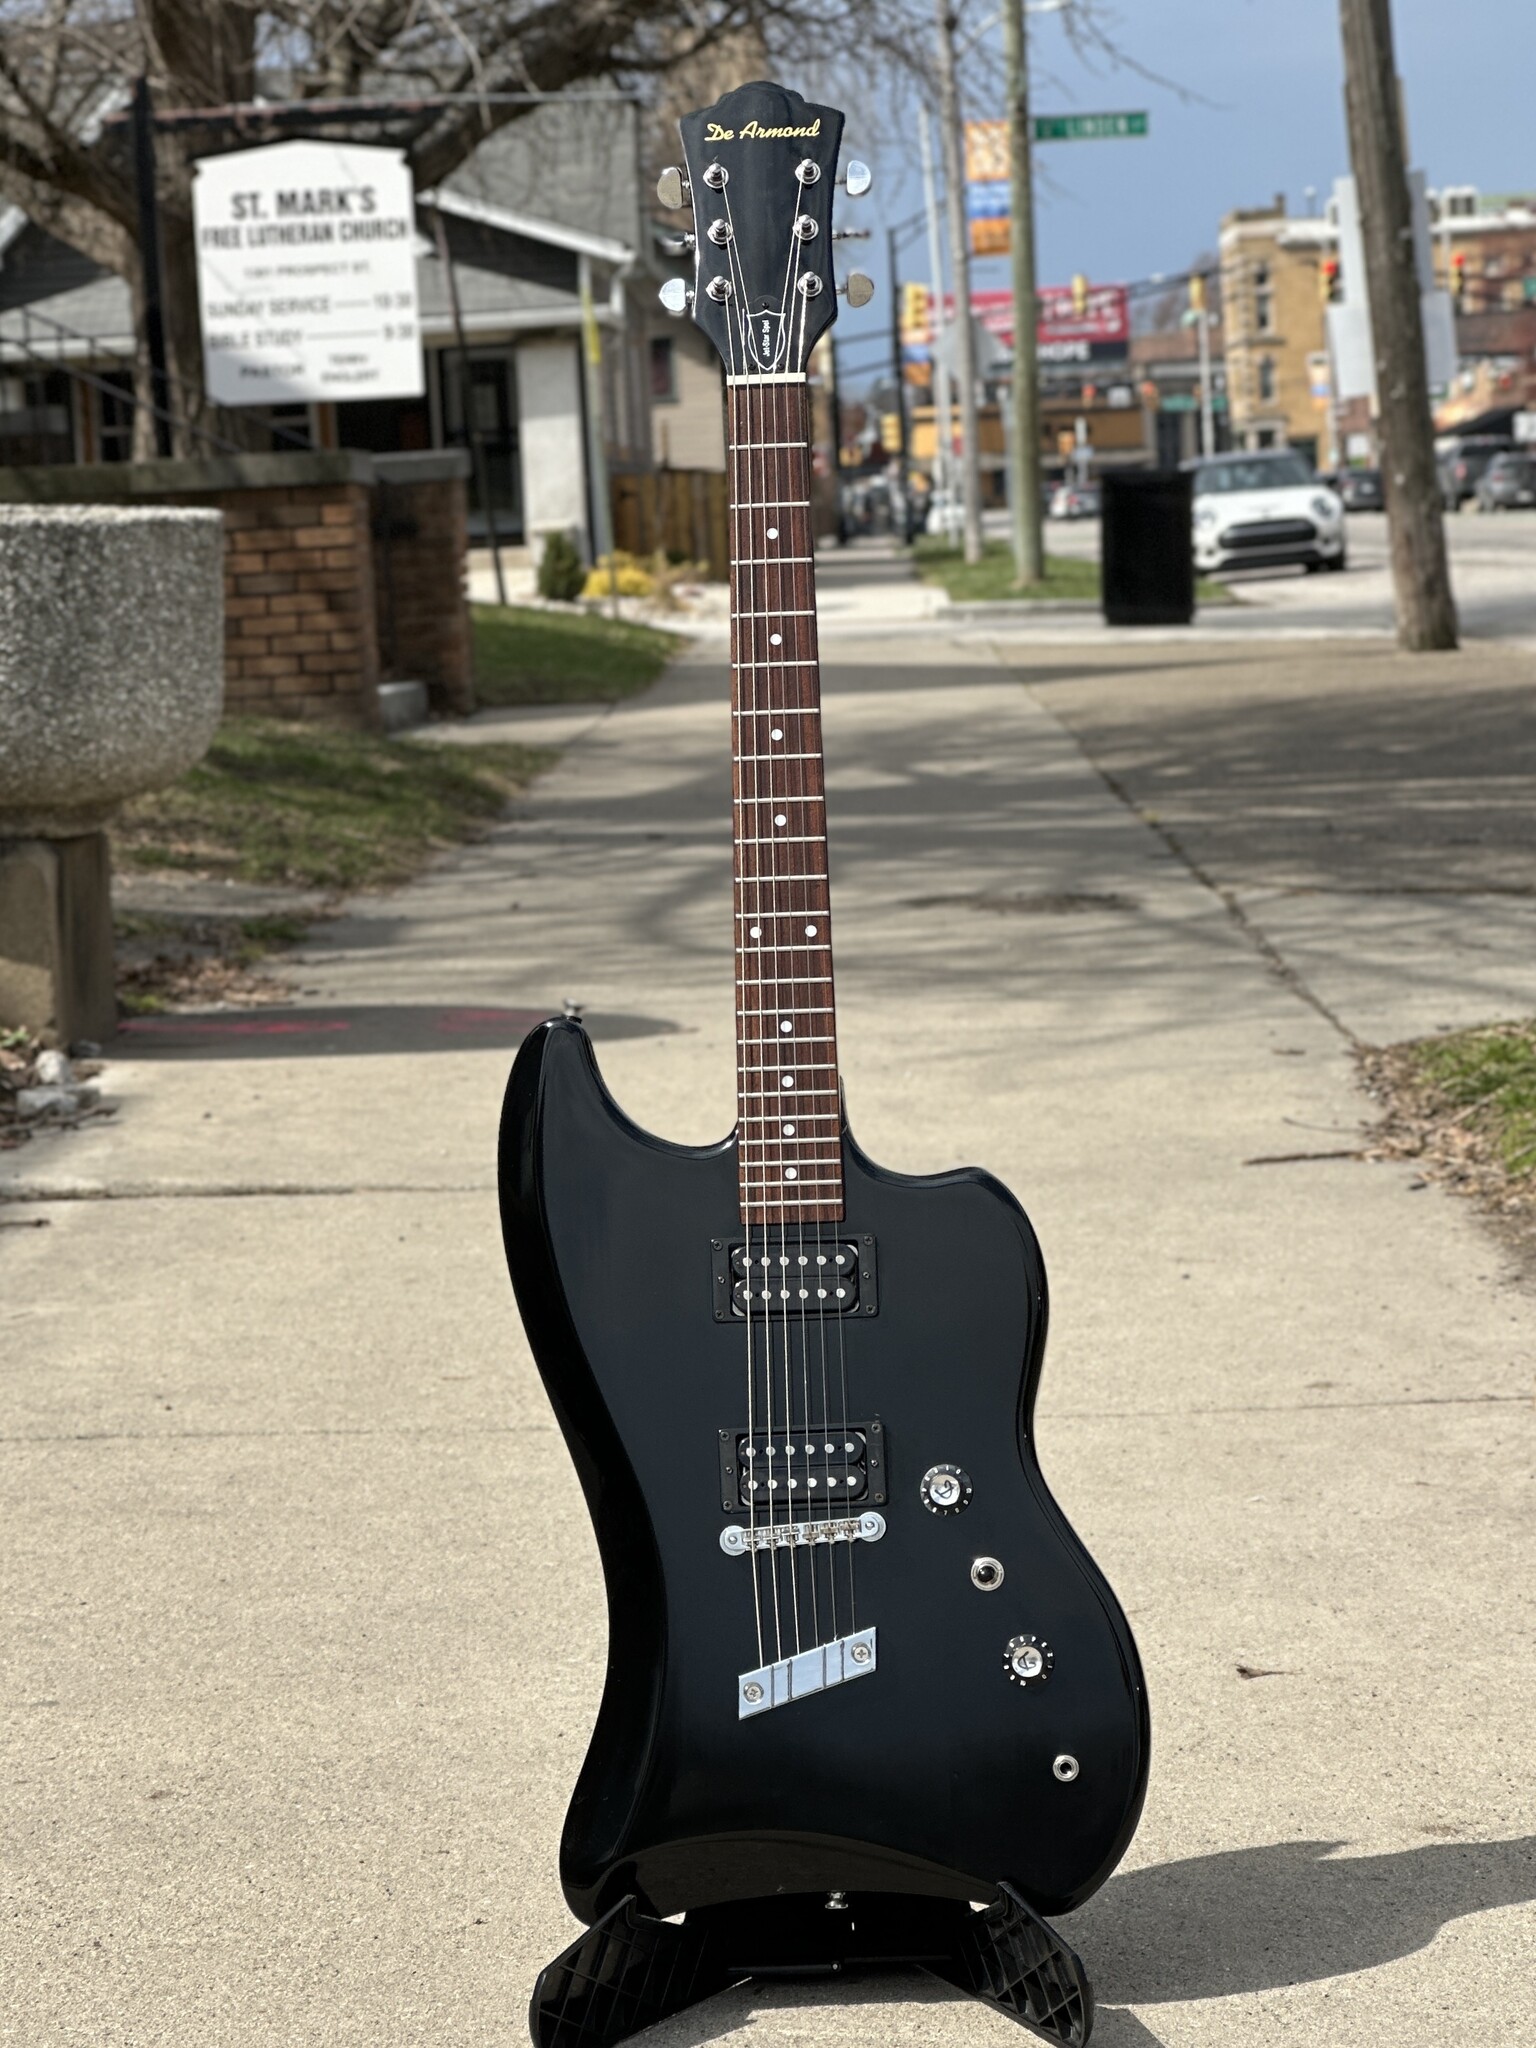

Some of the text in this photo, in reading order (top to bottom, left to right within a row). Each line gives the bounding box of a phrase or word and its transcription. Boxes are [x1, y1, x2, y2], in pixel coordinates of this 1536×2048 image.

[704, 118, 821, 142] De Armond
[231, 187, 376, 220] ST. MARK'S
[202, 219, 408, 248] FREE LUTHERAN CHURCH
[207, 300, 264, 319] SUNDAY
[270, 297, 332, 316] SERVICE
[208, 330, 250, 350] BIBLE
[255, 327, 304, 347] STUDY
